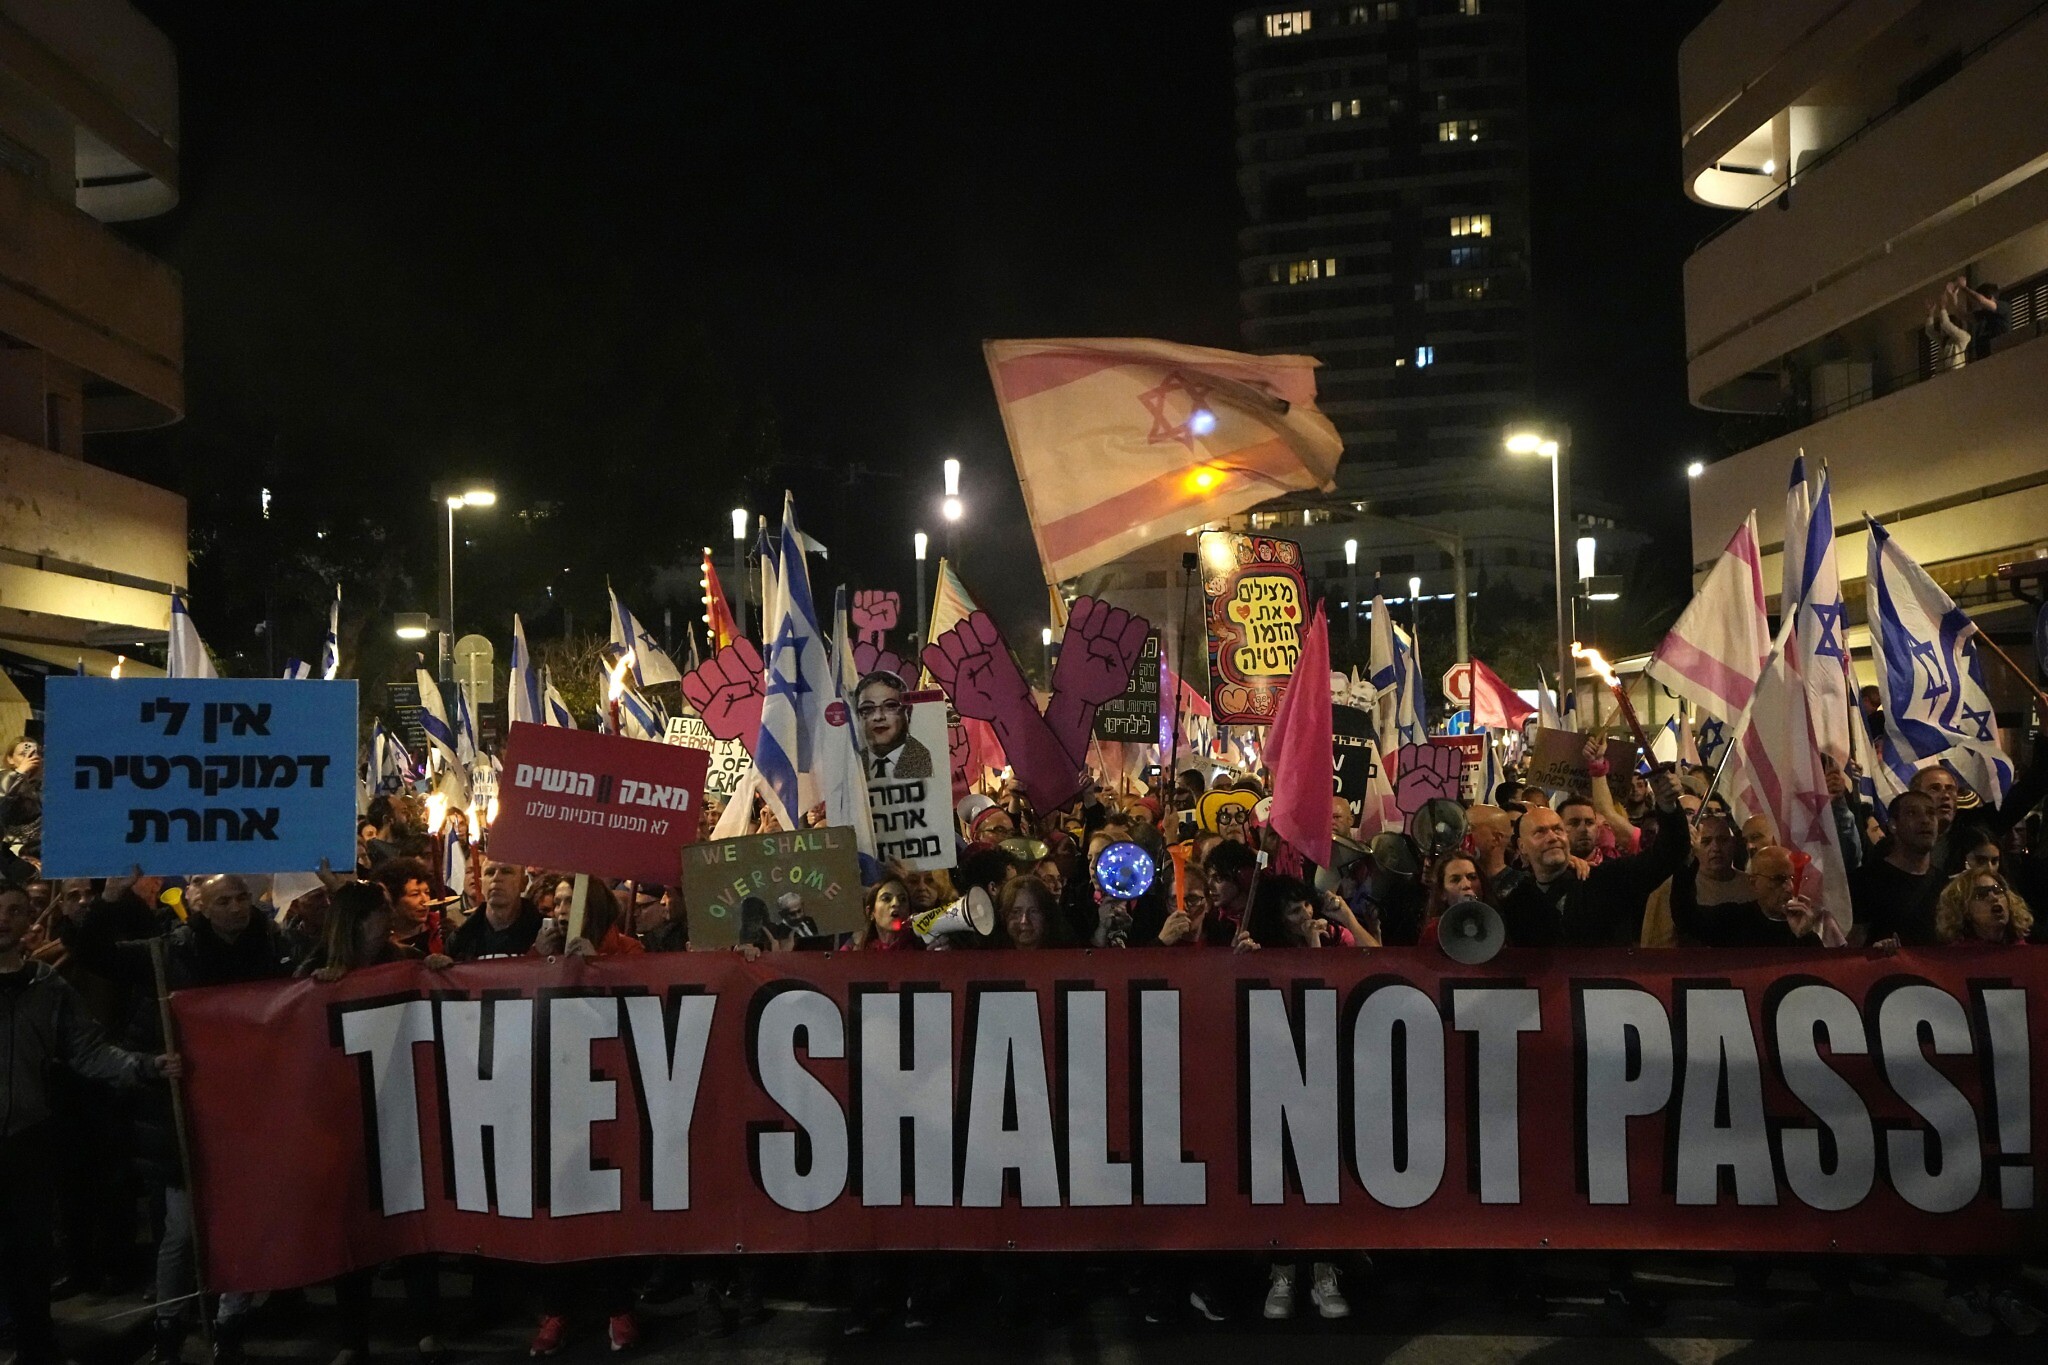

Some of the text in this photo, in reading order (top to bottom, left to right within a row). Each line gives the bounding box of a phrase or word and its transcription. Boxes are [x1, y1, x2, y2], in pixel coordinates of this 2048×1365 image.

[1238, 579, 1293, 603] מצילים
[1257, 605, 1282, 621] את
[1241, 646, 1299, 672] קרטיה
[140, 697, 272, 743] אין לי
[719, 741, 734, 755] IS
[75, 755, 331, 796] דמוקרטיה
[515, 763, 595, 797] הנשים
[723, 757, 749, 772] OF
[619, 779, 690, 811] מאבק
[870, 780, 925, 807] ממה
[125, 807, 280, 844] אחרת
[526, 801, 669, 835] לא תפגעו בזכויות שלנו
[872, 808, 928, 833] אתה
[701, 832, 839, 865] WE SHALL
[709, 866, 842, 918] OVERCOME
[338, 983, 2035, 1219] THEY SHALL NOT PASS!
